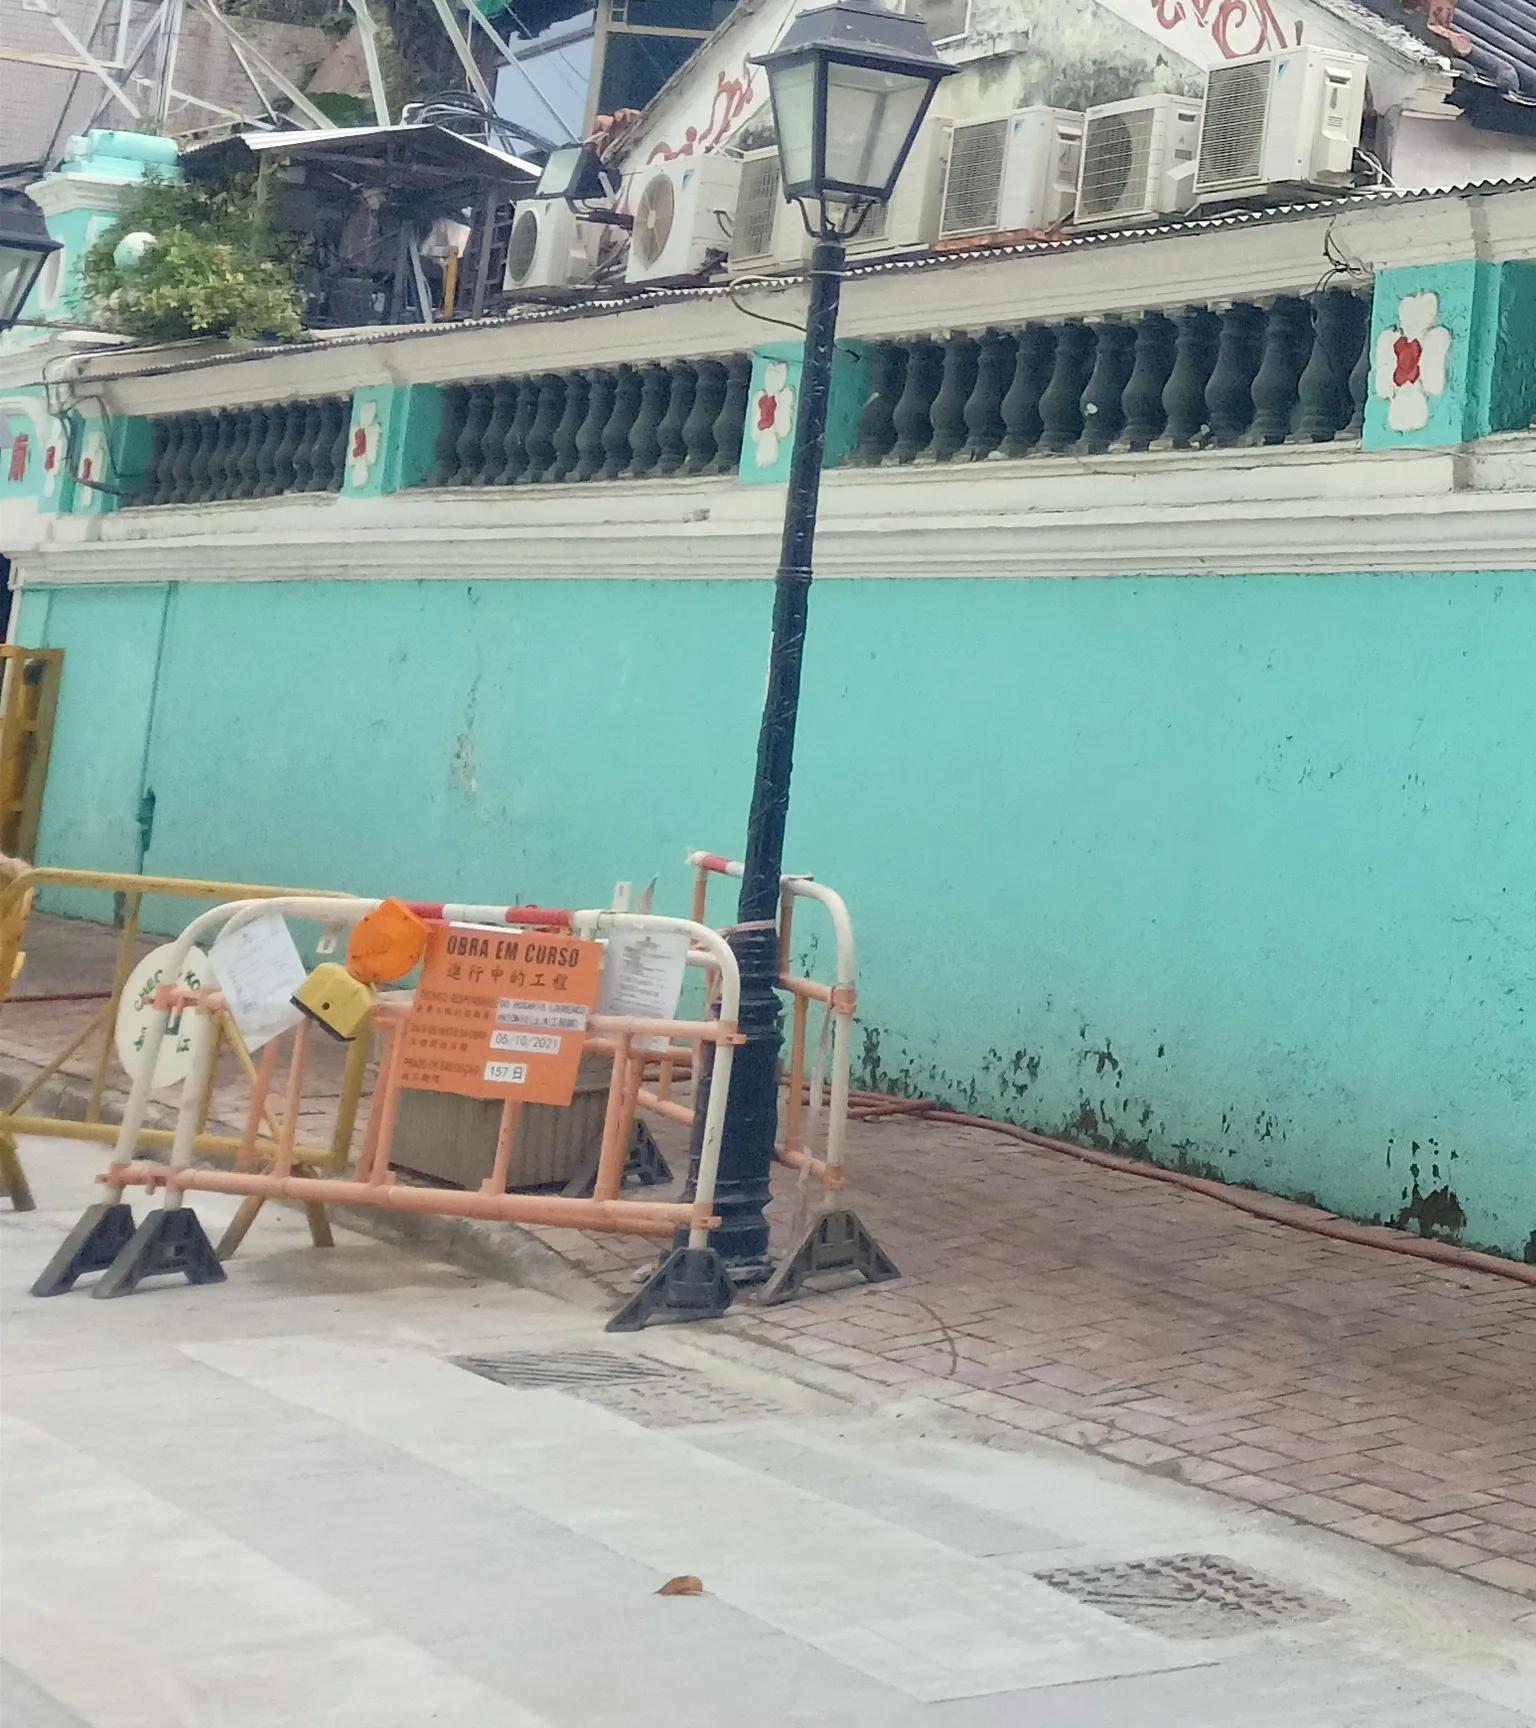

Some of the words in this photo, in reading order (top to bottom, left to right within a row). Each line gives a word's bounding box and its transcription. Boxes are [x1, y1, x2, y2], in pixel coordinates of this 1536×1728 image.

[446, 935, 489, 961] OBRA
[495, 941, 519, 961] EM
[524, 943, 580, 968] CURSO
[446, 961, 569, 991] 進行中的工程
[495, 1035, 558, 1050] 05/10/2021
